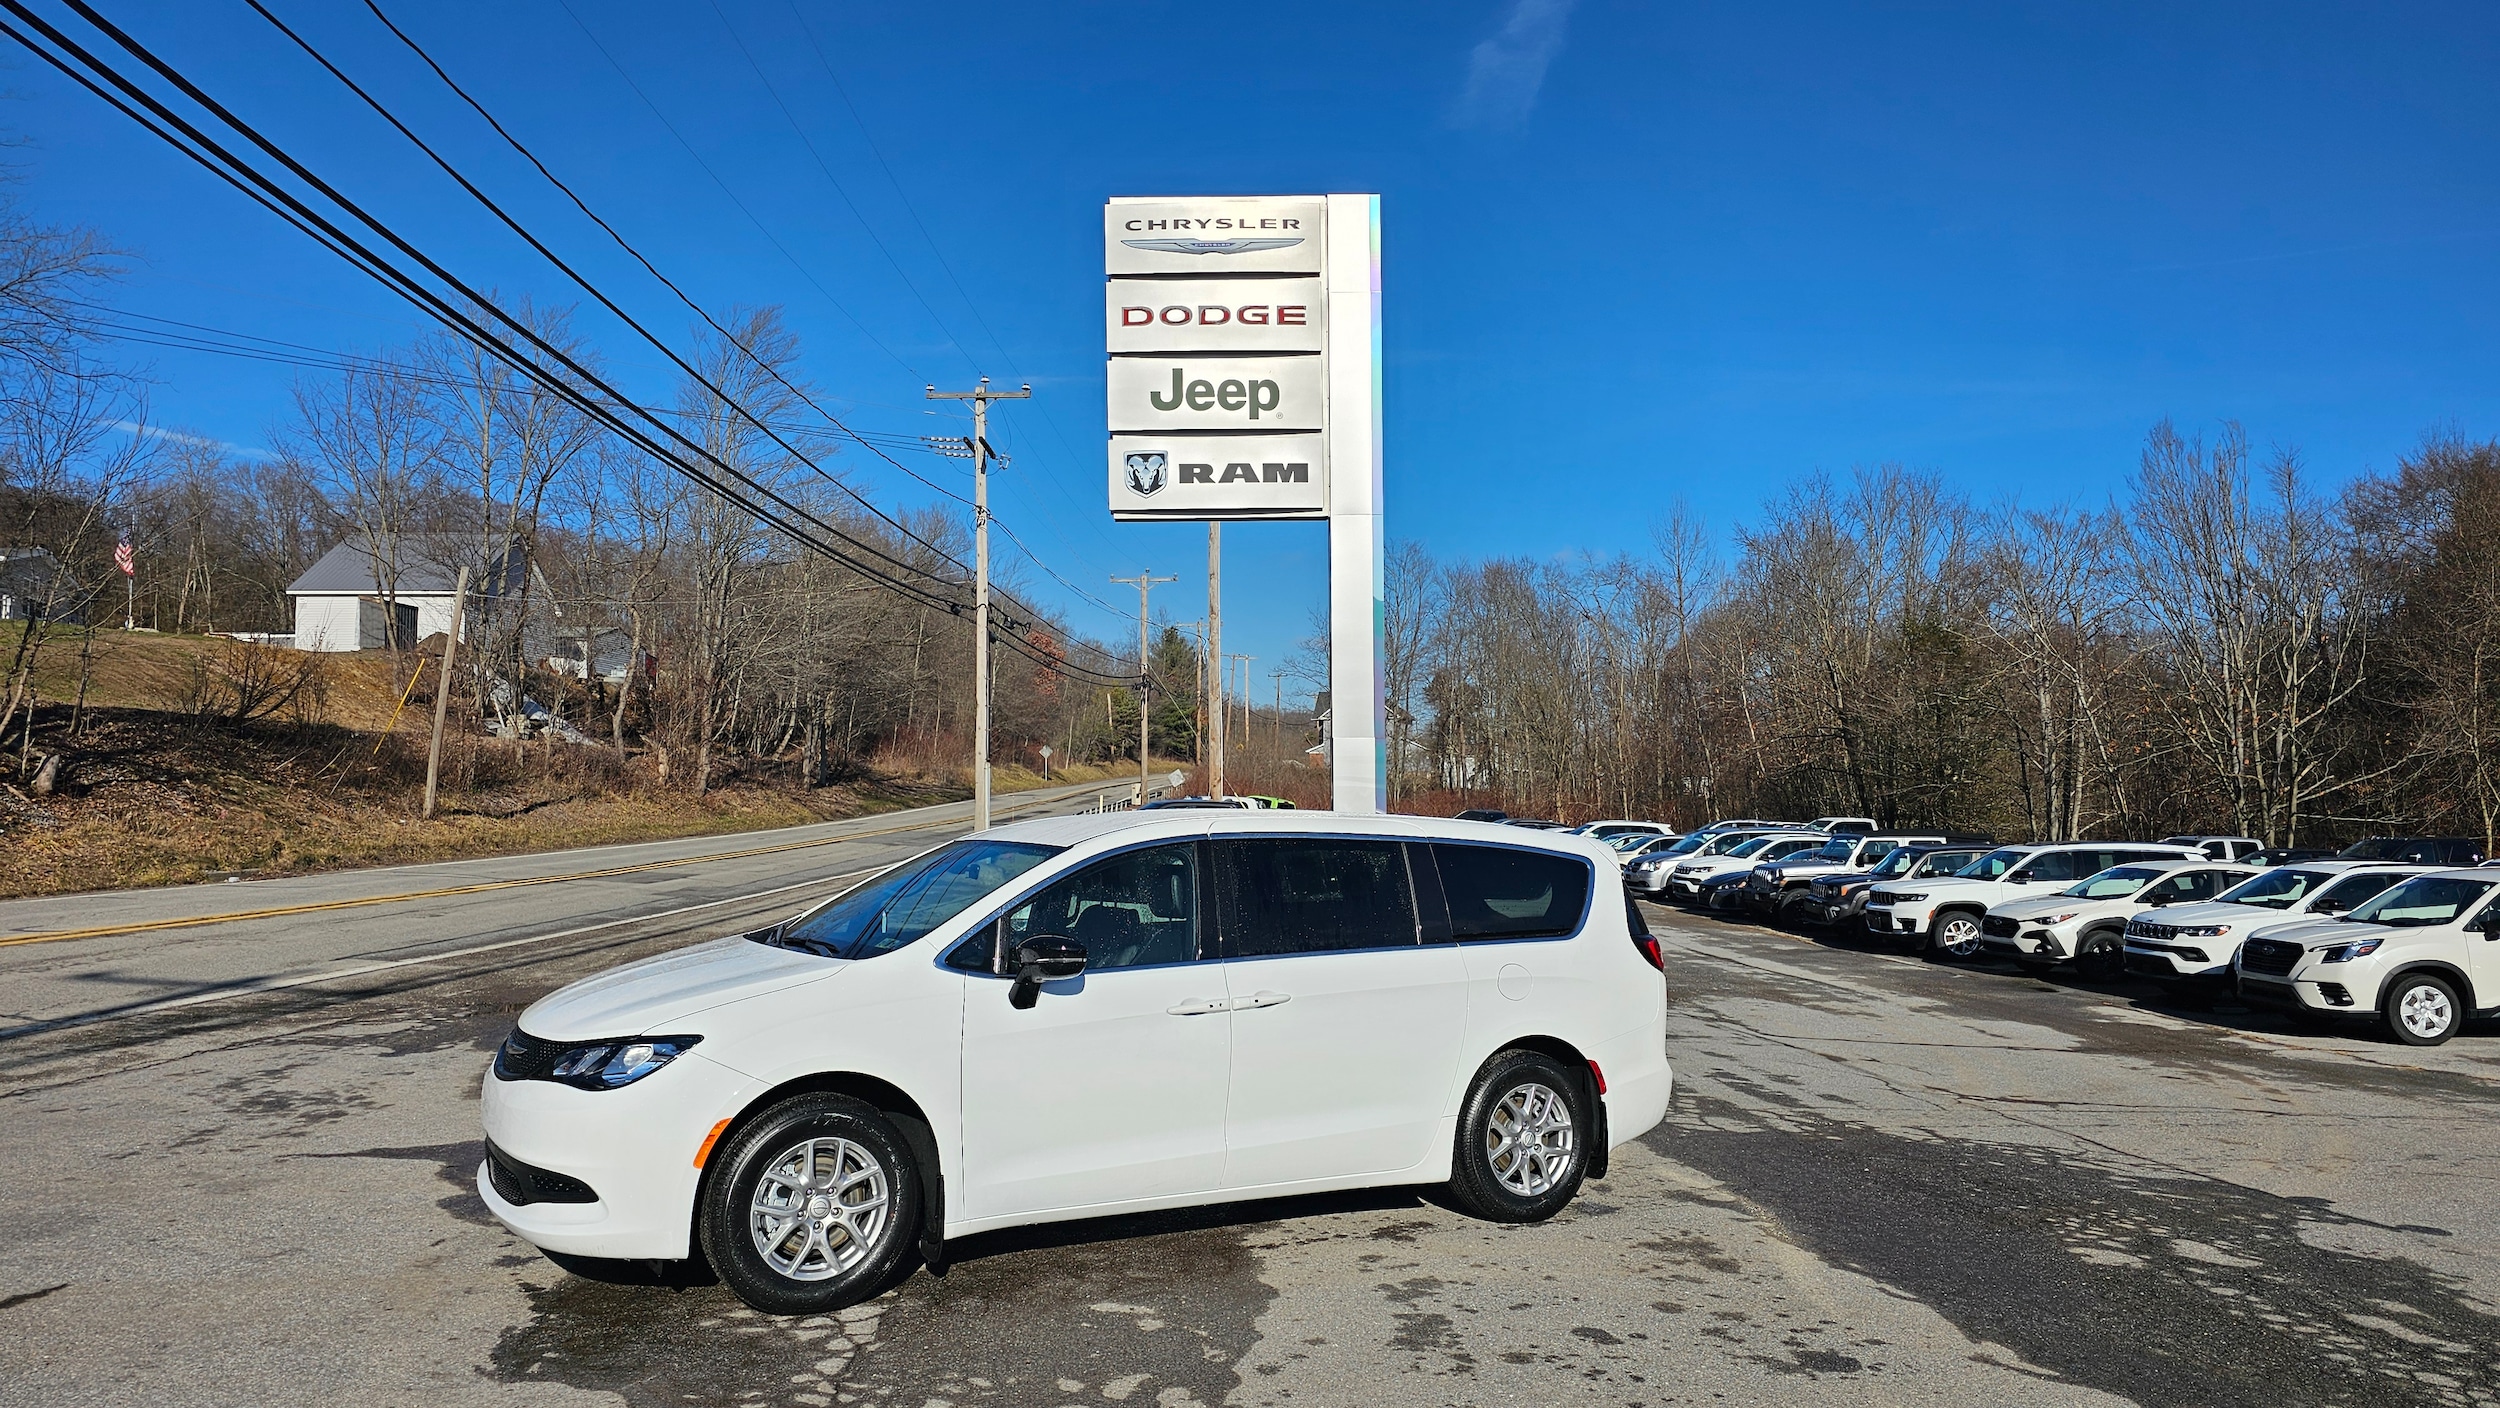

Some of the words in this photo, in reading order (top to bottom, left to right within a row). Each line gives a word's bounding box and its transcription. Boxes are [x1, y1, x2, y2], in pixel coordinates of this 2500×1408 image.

[1125, 218, 1301, 231] CHRYSLER
[1121, 305, 1307, 327] DODGE
[1150, 368, 1280, 420] Jeep
[1178, 463, 1309, 484] RAM
